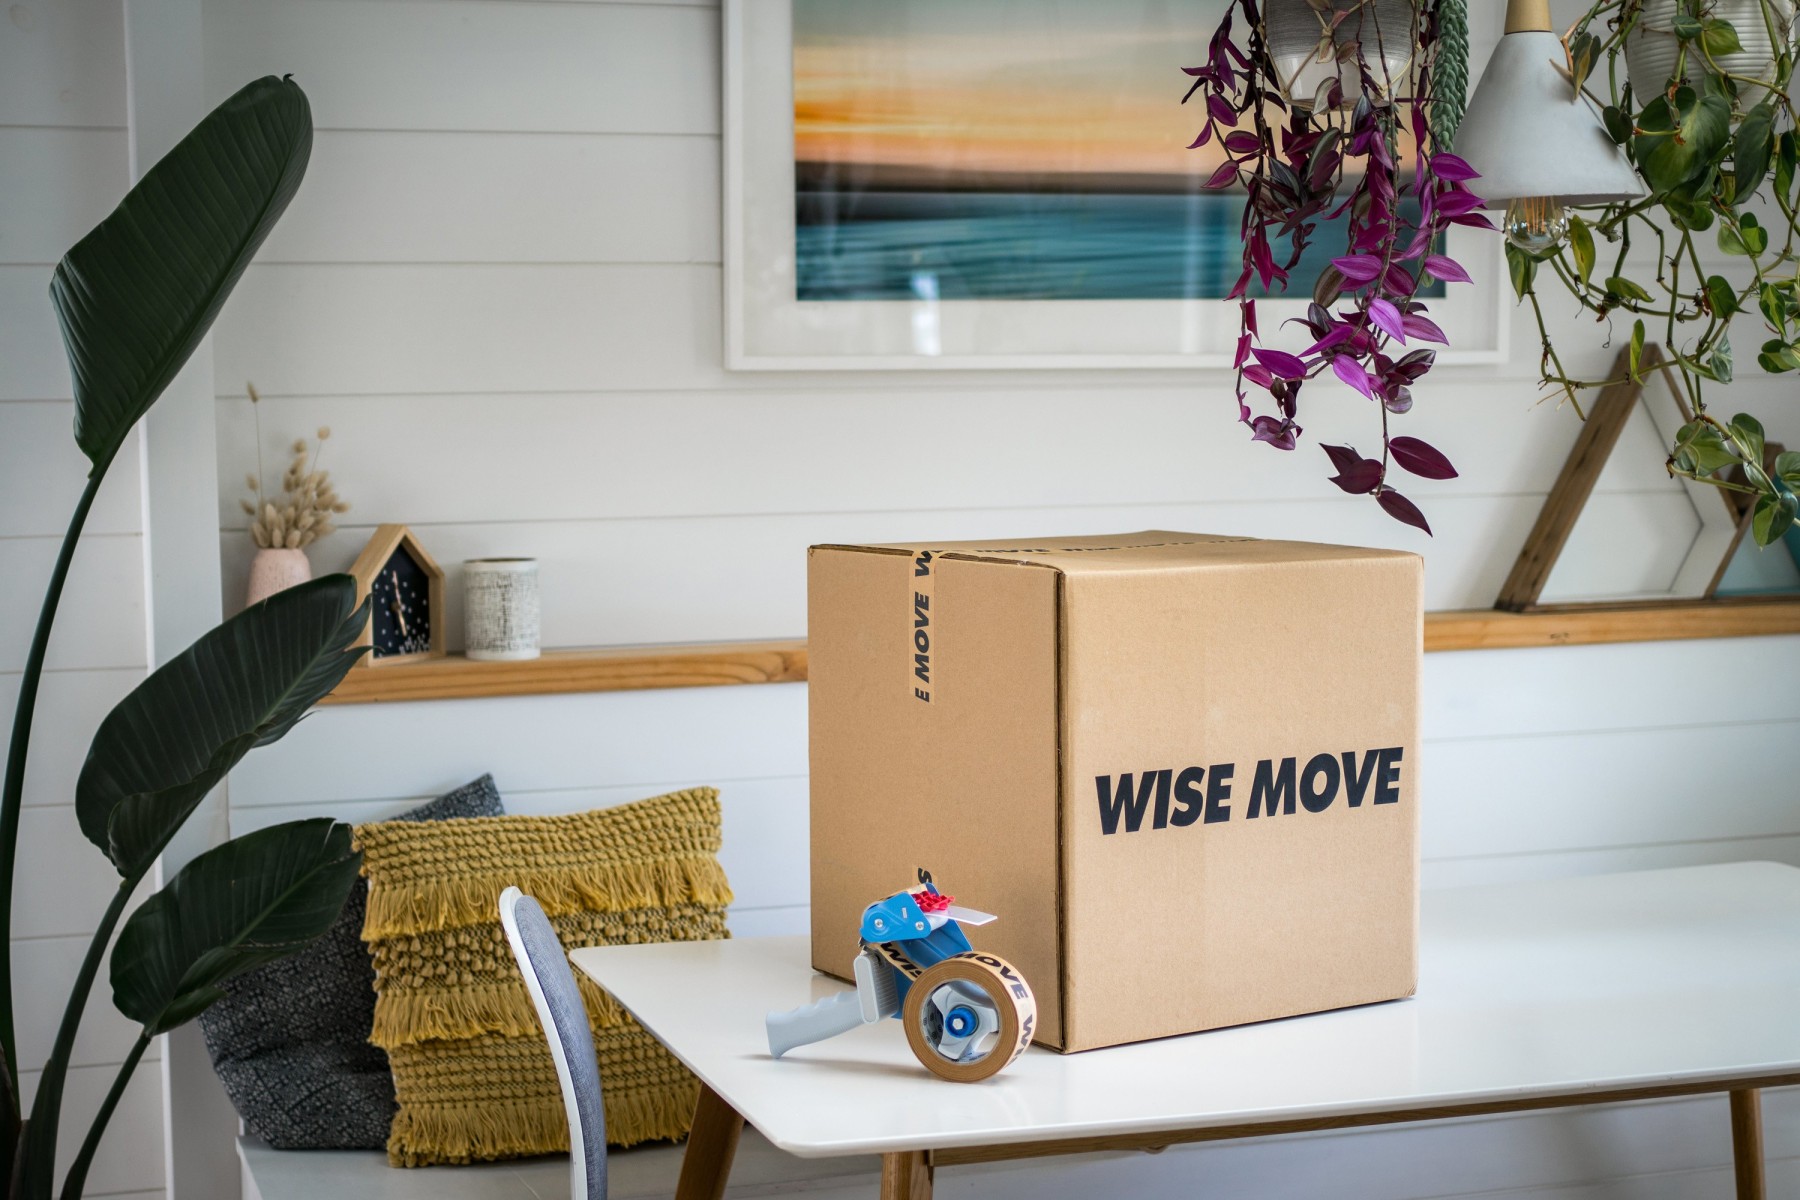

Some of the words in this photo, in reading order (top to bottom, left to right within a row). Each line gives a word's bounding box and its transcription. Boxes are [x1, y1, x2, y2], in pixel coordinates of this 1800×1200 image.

[914, 591, 930, 684] MOVE
[1095, 763, 1235, 836] WISE
[1246, 746, 1404, 820] MOVE
